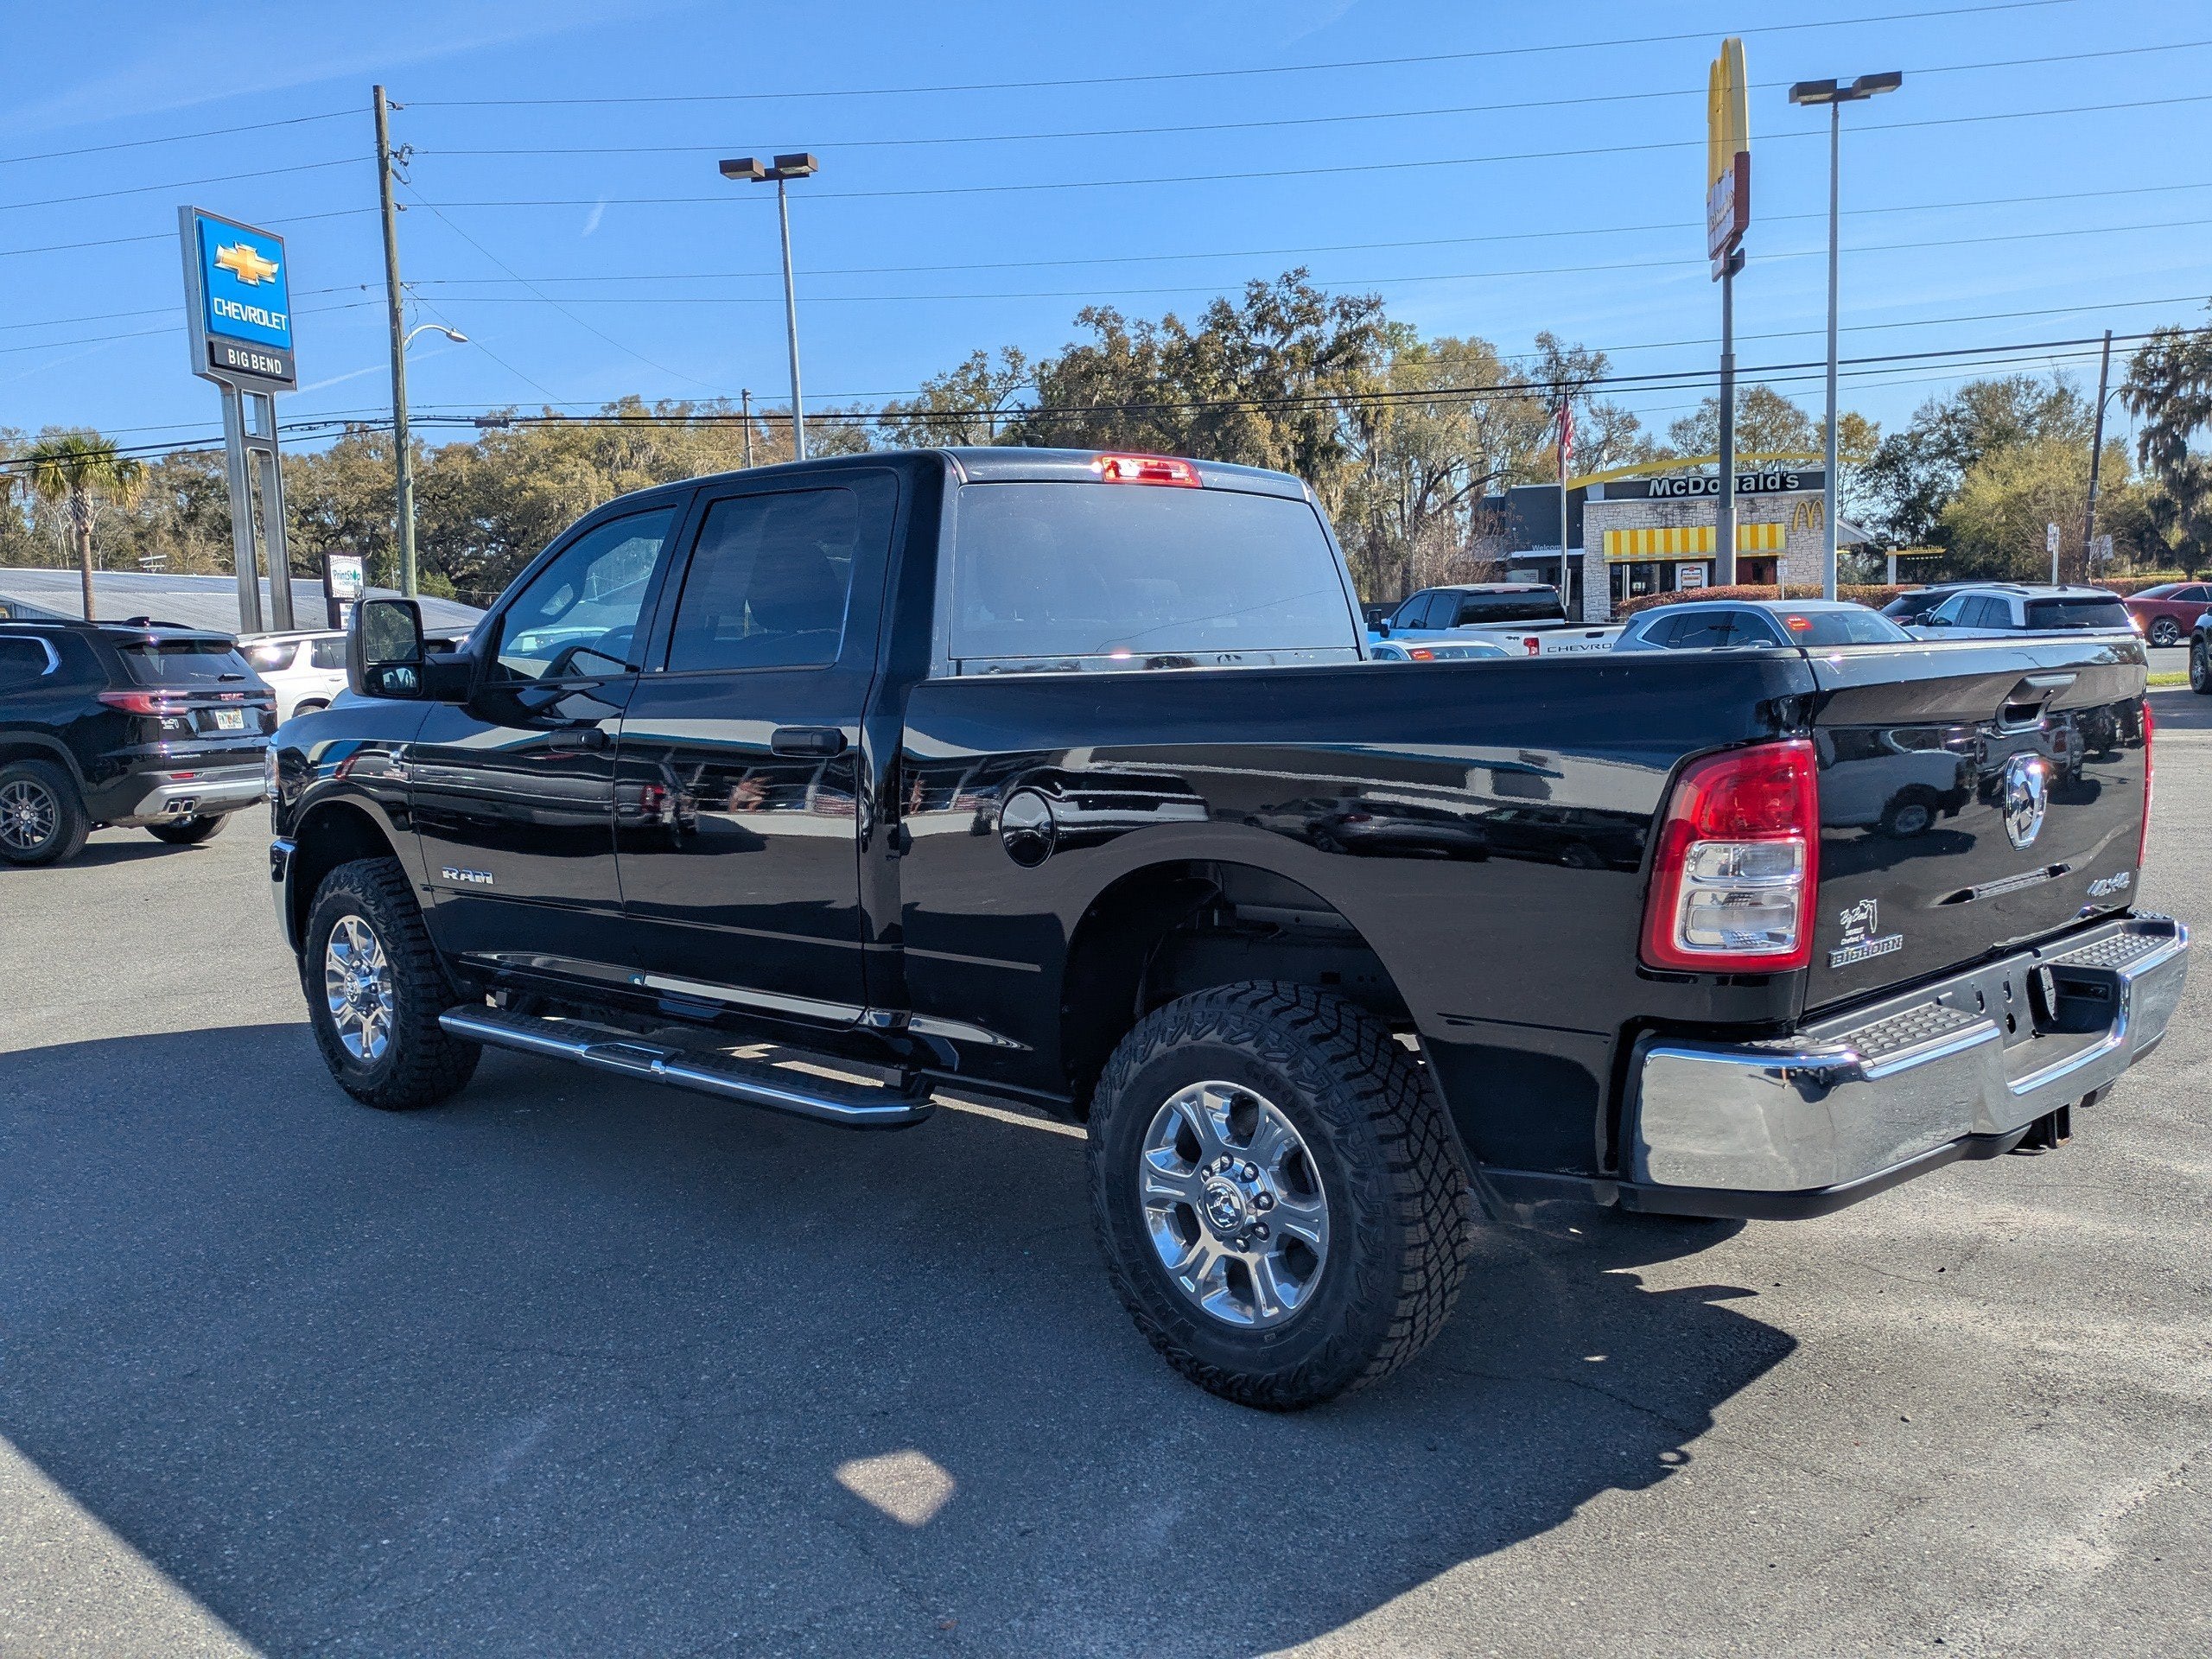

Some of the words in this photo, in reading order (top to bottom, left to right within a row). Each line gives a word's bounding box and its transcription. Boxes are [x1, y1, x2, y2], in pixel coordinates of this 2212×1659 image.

[213, 297, 287, 331] CHEVROLET
[228, 348, 249, 368] BIG
[251, 355, 283, 375] BEND
[1547, 643, 1615, 653] CHEVRO
[442, 867, 493, 884] RAM
